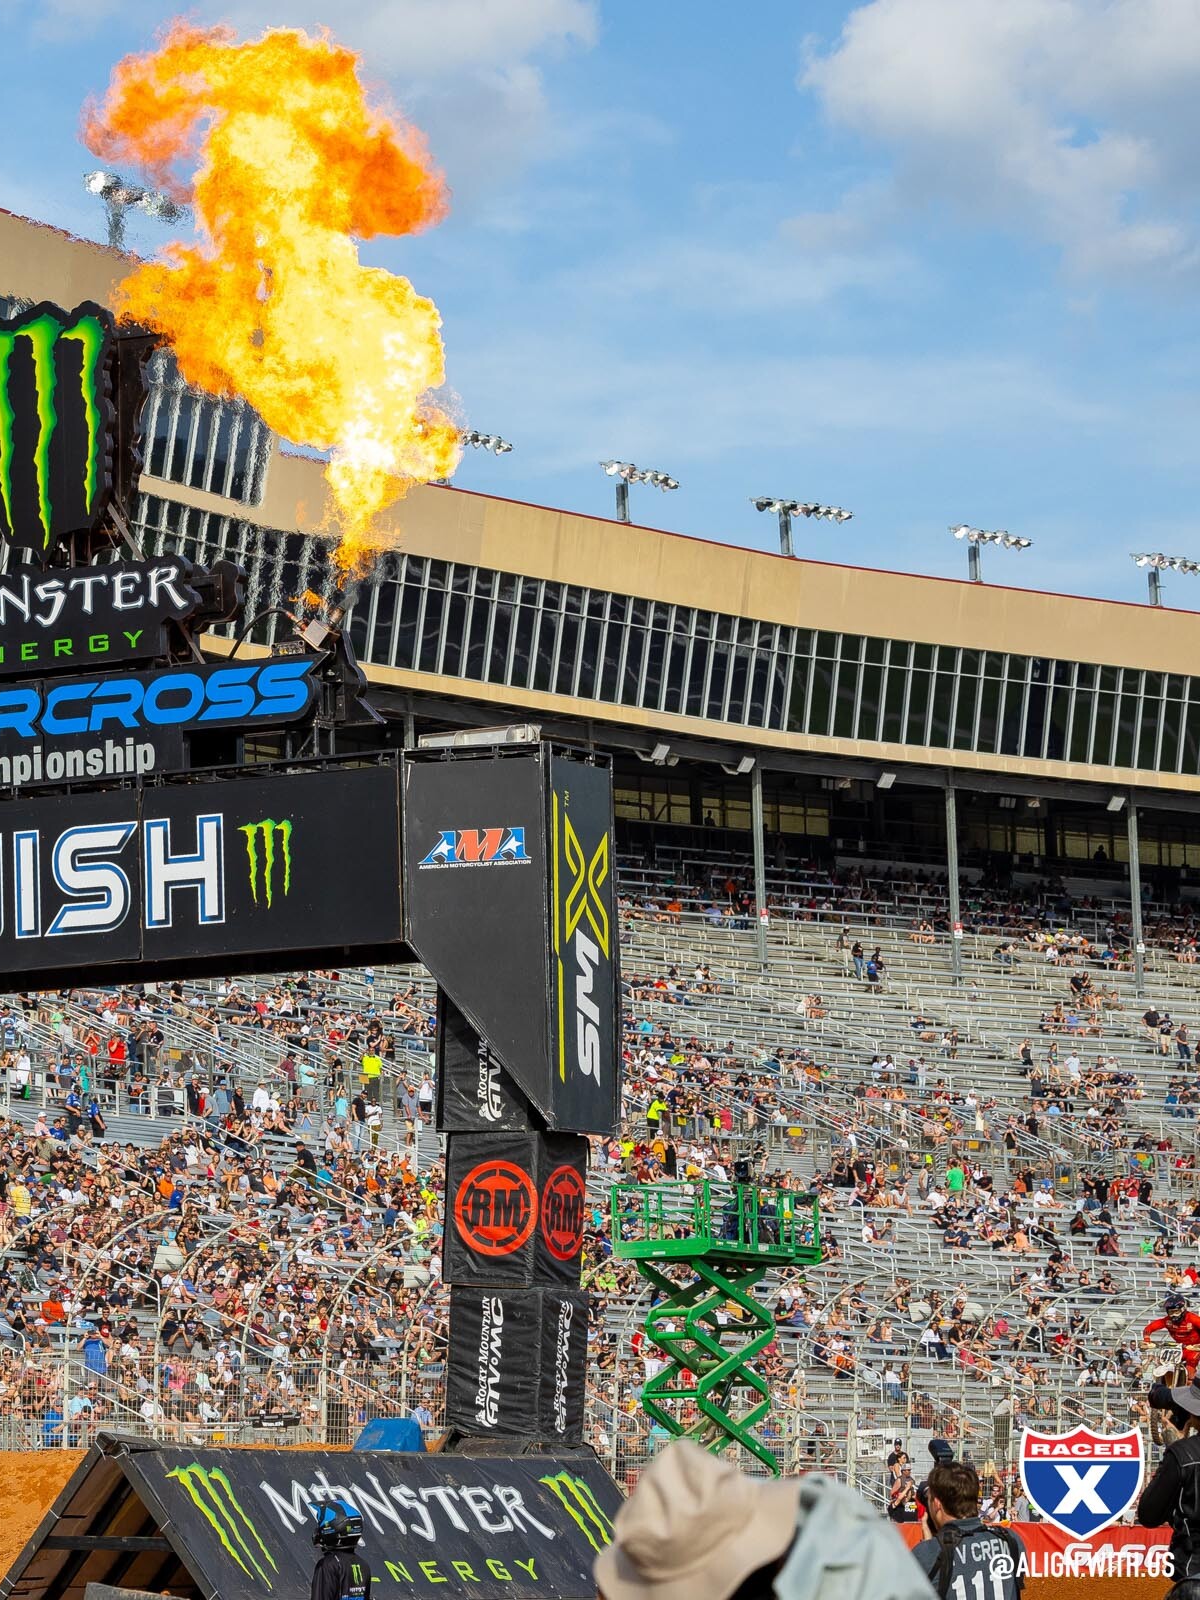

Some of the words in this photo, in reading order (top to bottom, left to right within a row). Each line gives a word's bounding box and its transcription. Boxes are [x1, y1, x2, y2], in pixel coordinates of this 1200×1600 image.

[417, 827, 532, 864] AMA
[450, 861, 493, 869] MOTORCYCLIST
[477, 1059, 488, 1100] ROCKY
[471, 1188, 520, 1228] RM
[550, 1193, 583, 1229] RM
[478, 1295, 490, 1369] MOUNTAIN
[556, 1300, 567, 1374] MOUNTAIN
[475, 1370, 488, 1412] ROCKY
[554, 1375, 564, 1416] ROCKY
[370, 1557, 537, 1584] NERGY
